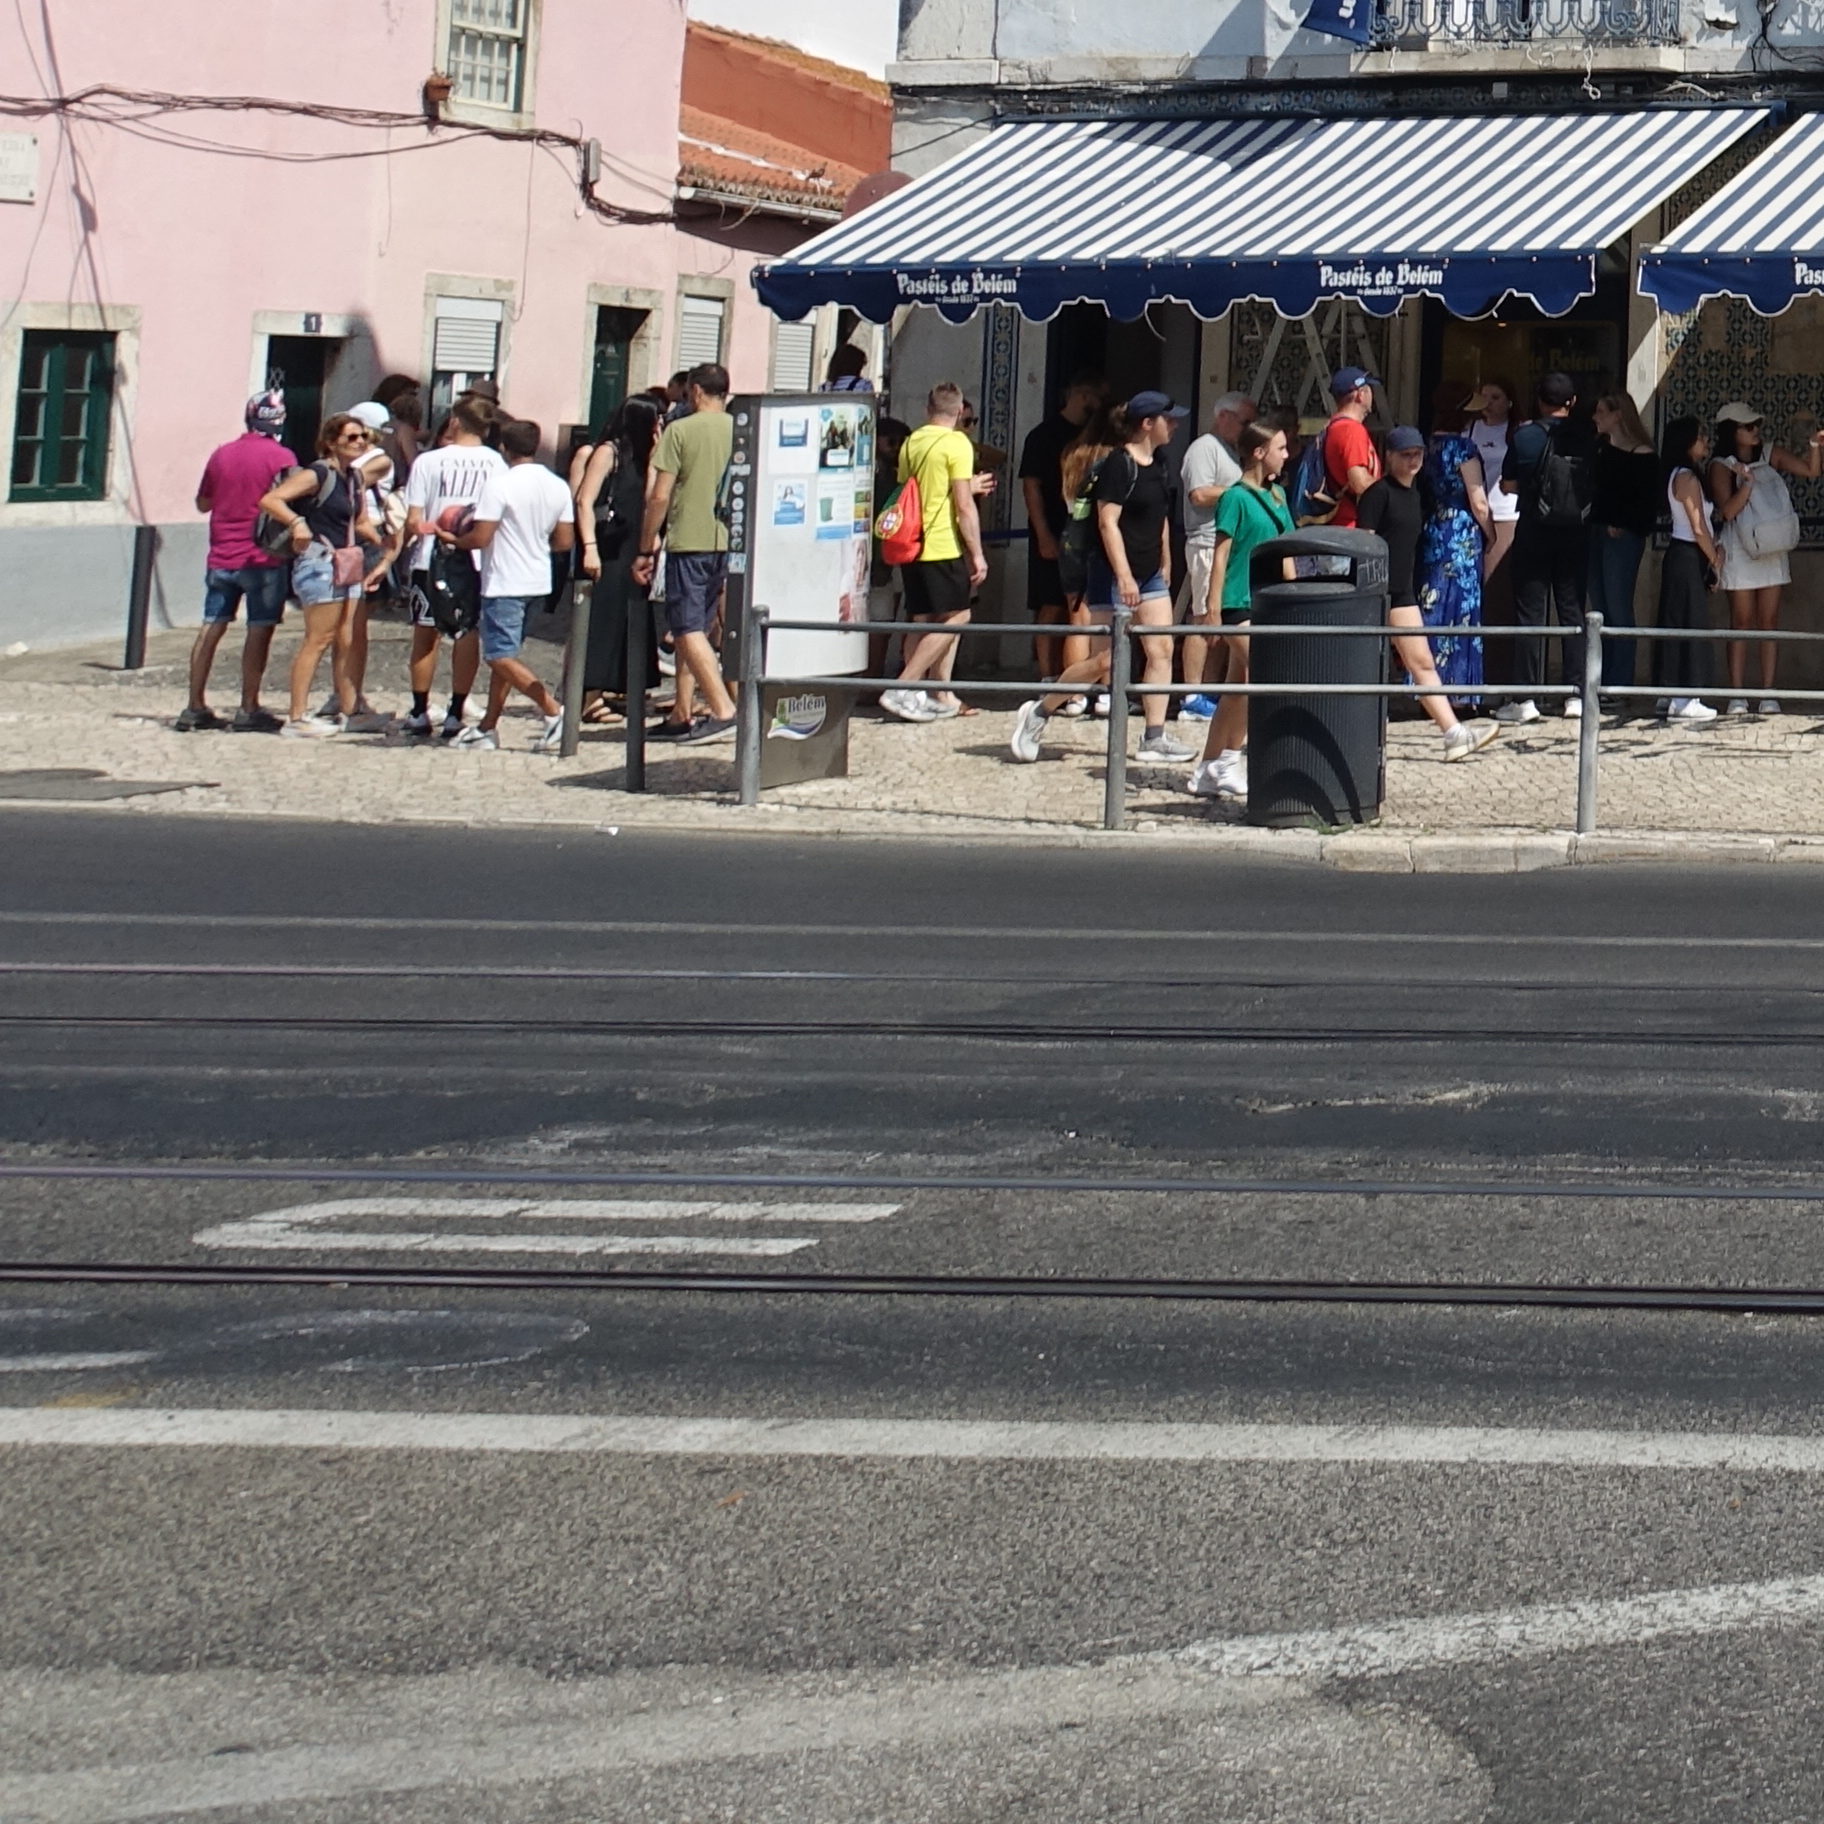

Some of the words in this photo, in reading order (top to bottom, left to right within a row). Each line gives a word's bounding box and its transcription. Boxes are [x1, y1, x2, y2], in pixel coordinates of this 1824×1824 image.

[896, 273, 948, 295] Pastéis
[952, 275, 969, 294] de
[972, 272, 1017, 294] Belém
[1320, 265, 1372, 288] Pastéis
[1375, 266, 1394, 286] de
[1396, 264, 1443, 286] Belém
[310, 315, 316, 331] 1
[440, 459, 495, 468] CALVIN
[788, 694, 825, 713] Belém
